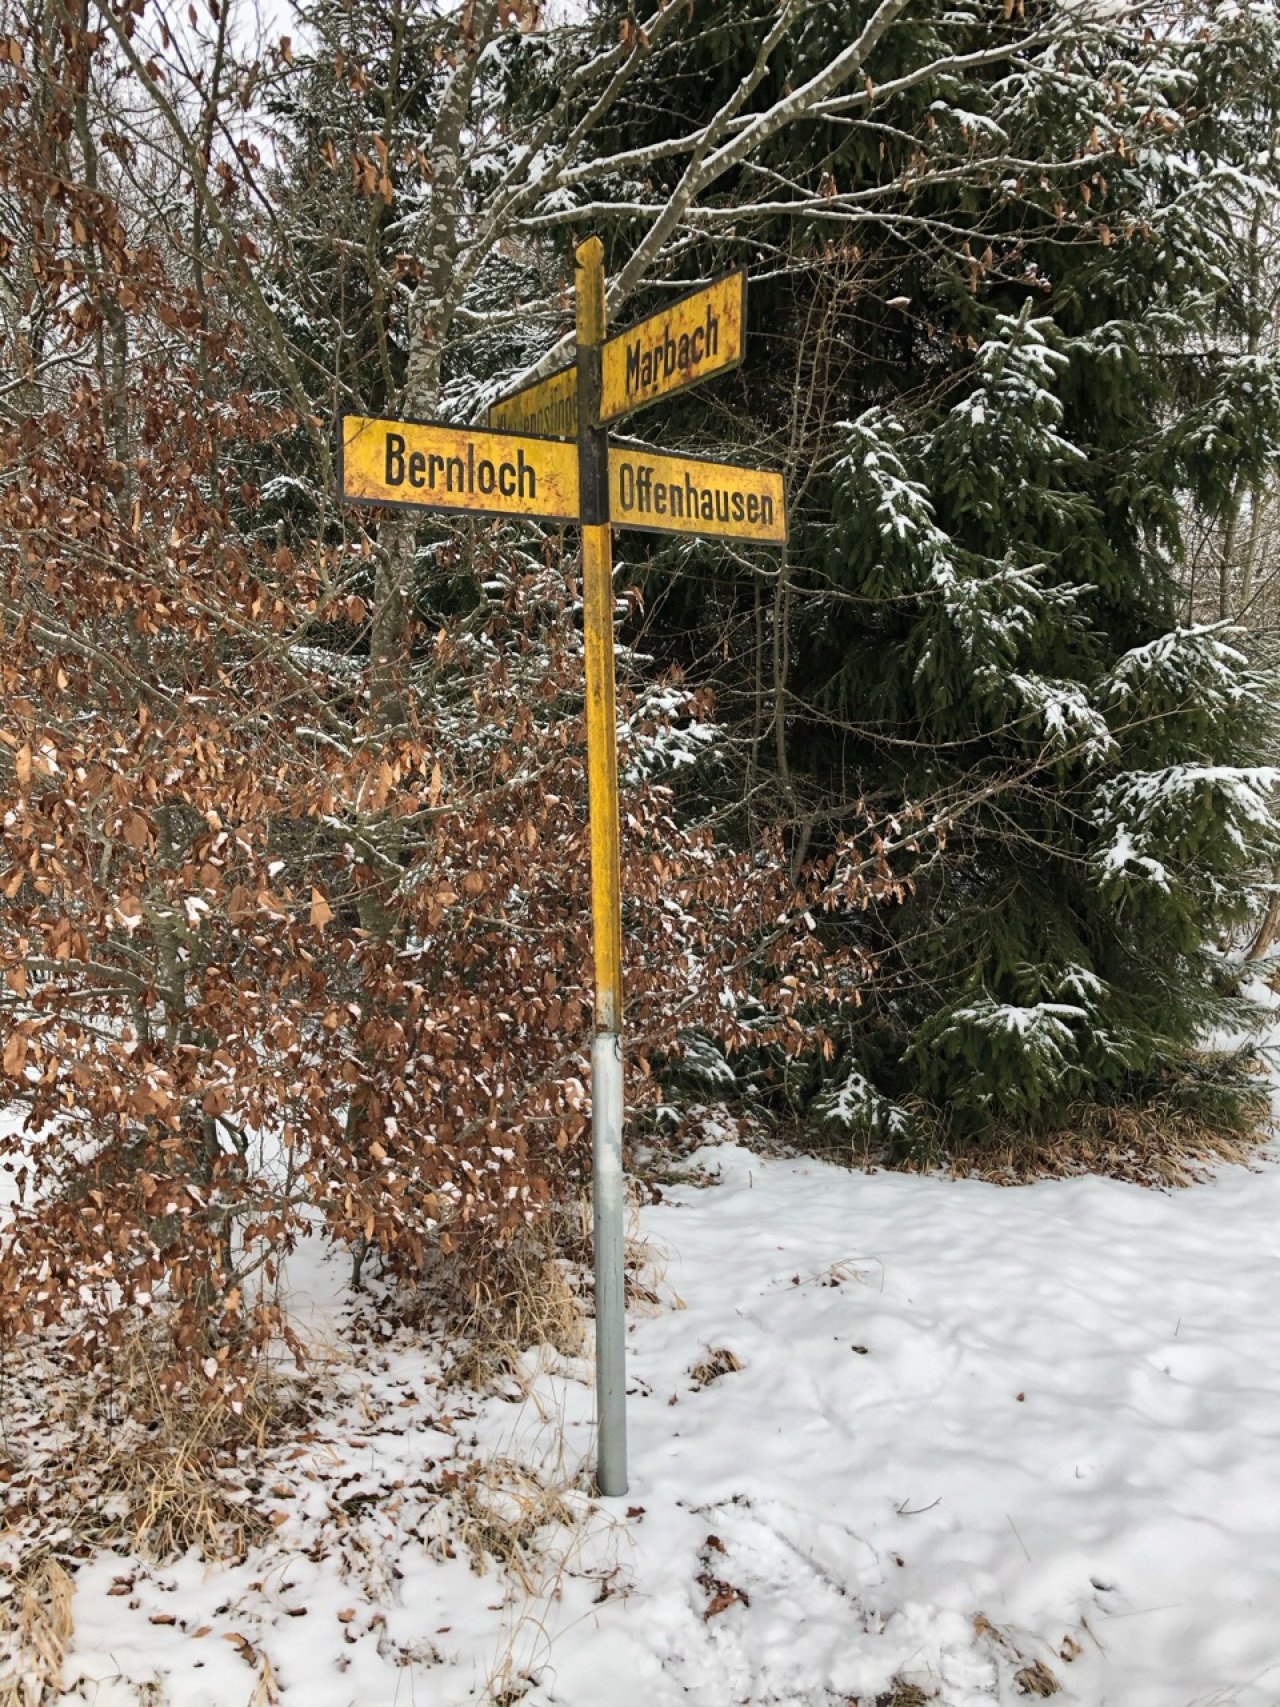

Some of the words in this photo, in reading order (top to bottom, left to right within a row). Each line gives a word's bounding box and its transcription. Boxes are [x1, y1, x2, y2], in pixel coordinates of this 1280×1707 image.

[626, 304, 718, 395] Marbach
[385, 432, 536, 499] Bernloch
[619, 463, 773, 525] Offenhausen
